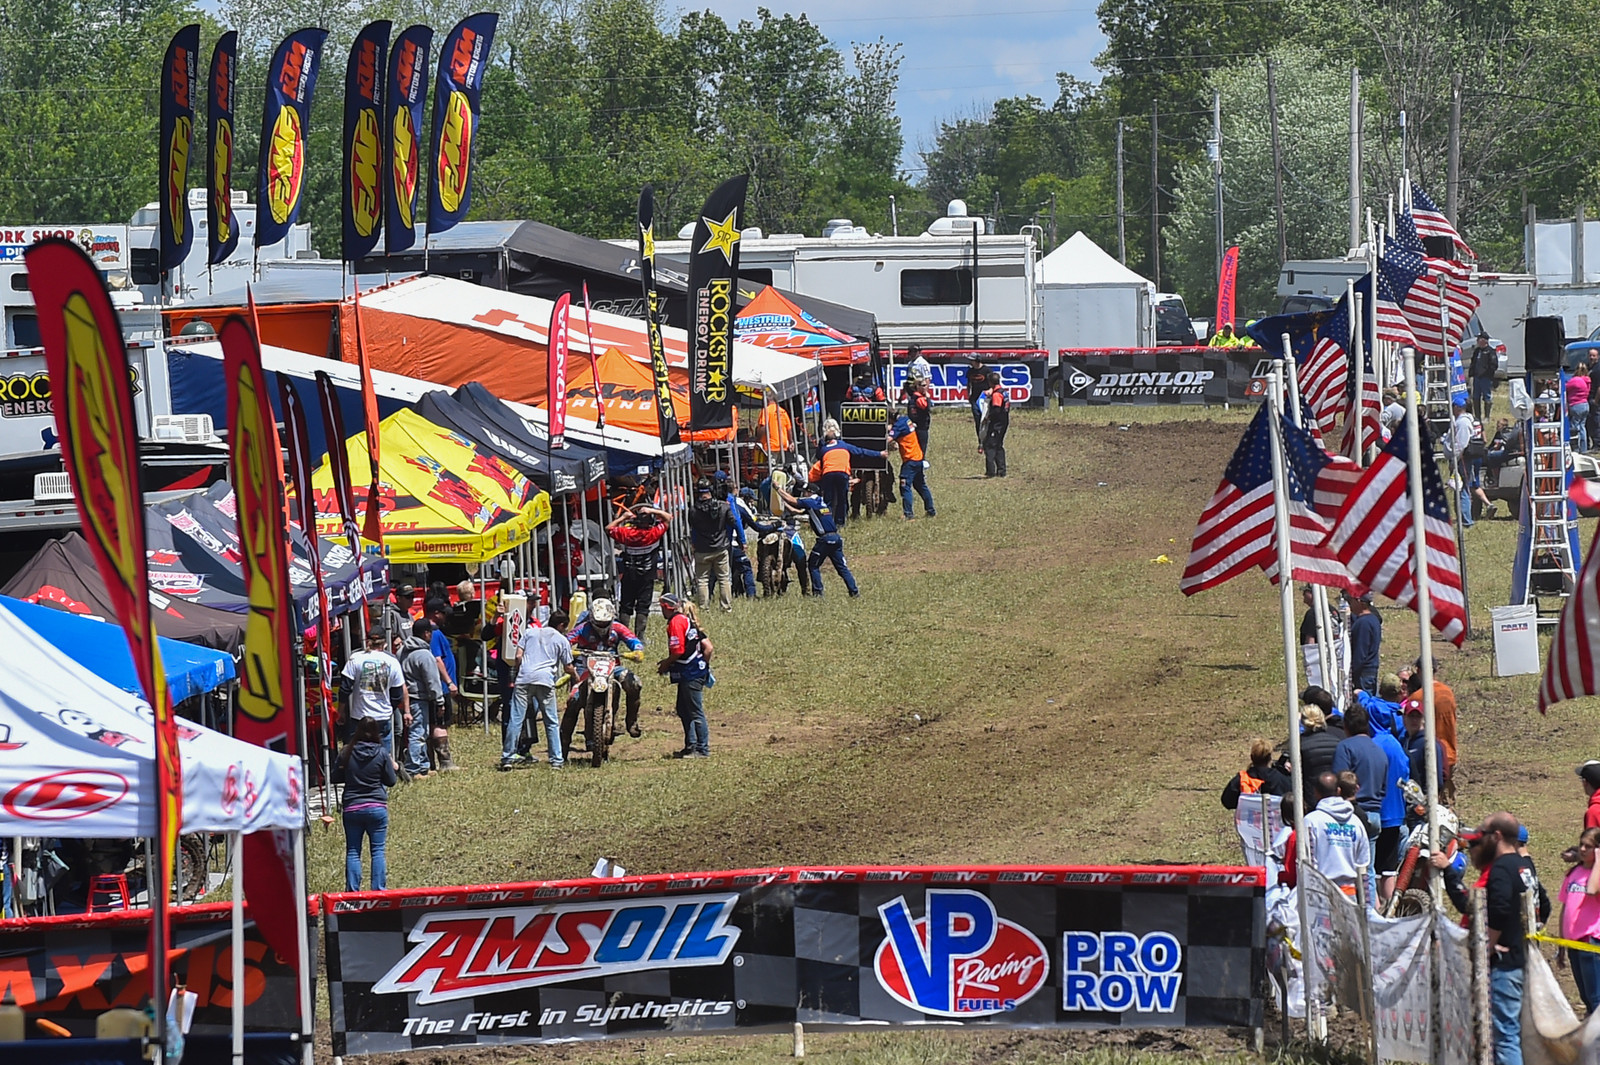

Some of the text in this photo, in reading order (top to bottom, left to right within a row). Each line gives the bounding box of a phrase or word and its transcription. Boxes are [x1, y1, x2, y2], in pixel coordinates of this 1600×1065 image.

[279, 40, 307, 100] KTM
[356, 39, 375, 100] KTM
[396, 38, 416, 99] KTM
[450, 27, 476, 85] KTM
[466, 34, 483, 89] FACTORY RACING
[355, 108, 377, 237] FMF
[443, 91, 465, 213] FMF
[696, 288, 709, 393] ENERGY DRINK
[738, 314, 791, 327] WESTFIELD
[1092, 385, 1205, 397] MOTORCYCLE TIRES
[1095, 371, 1214, 388] DUNLOP
[842, 408, 887, 422] KAILUB
[414, 540, 474, 553] Obermeyer
[398, 900, 732, 993] AMSOIL
[877, 888, 998, 1013] VP
[1063, 931, 1180, 974] PRO
[957, 952, 1044, 997] Racing
[1063, 972, 1183, 1012] ROW
[401, 1017, 455, 1037] The
[460, 1010, 532, 1031] First
[538, 1007, 567, 1026] in
[957, 998, 1017, 1011] FUELS
